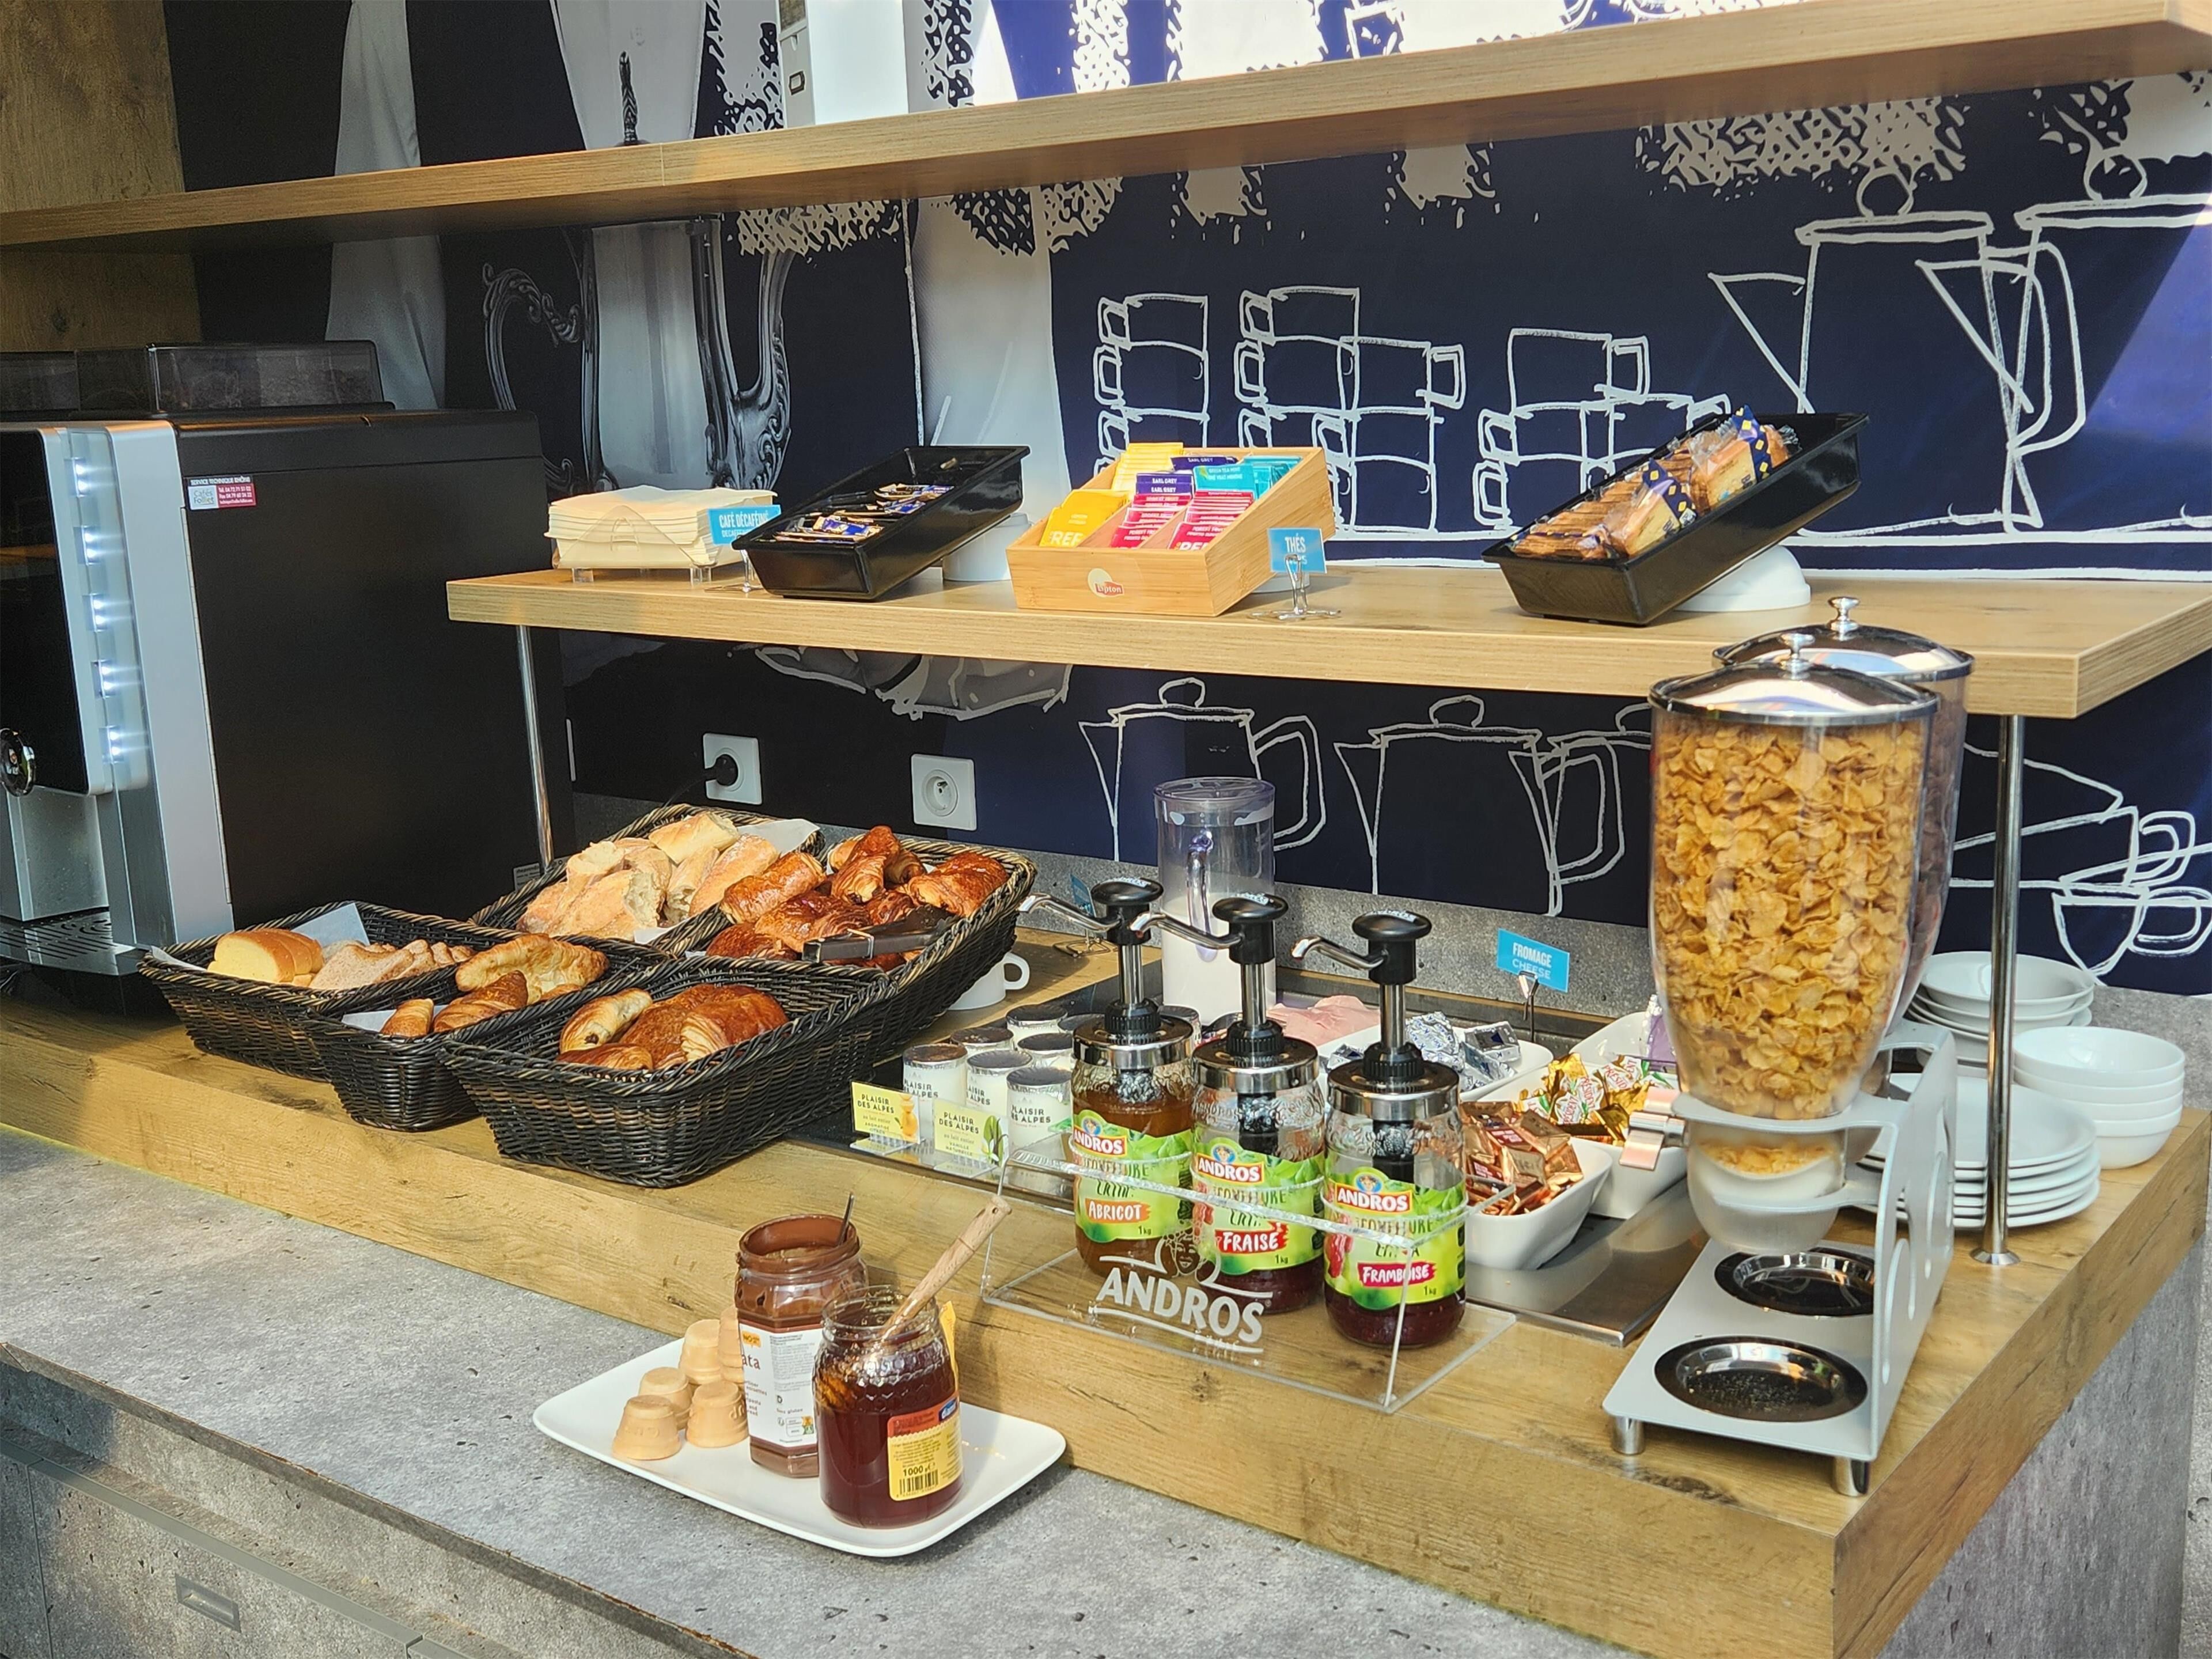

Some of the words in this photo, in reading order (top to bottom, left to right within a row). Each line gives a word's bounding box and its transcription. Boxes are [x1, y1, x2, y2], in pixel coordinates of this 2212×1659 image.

[719, 512, 736, 528] CAFÉ
[1284, 532, 1306, 553] THÉS
[1097, 585, 1122, 594] Lipton
[1513, 942, 1552, 968] FROMAGE
[1512, 958, 1551, 979] CHEESE
[857, 1100, 870, 1109] DES
[873, 1104, 895, 1114] ALPES
[861, 1093, 889, 1105] PLAISIR
[970, 1094, 991, 1105] ALPES
[939, 1118, 953, 1127] DES
[956, 1123, 979, 1134] ALPES
[944, 1111, 974, 1125] PLAISIR
[1074, 1128, 1123, 1155] ANDROS
[1198, 1157, 1260, 1181] ANDROS
[1338, 1187, 1408, 1212] ANDROS
[1088, 1200, 1142, 1221] ABRICOT
[1222, 1232, 1279, 1252] FRAISE
[1362, 1264, 1430, 1284] FRAMBOISE
[1096, 1267, 1264, 1343] ANDROS
[903, 1465, 924, 1477] 1000
